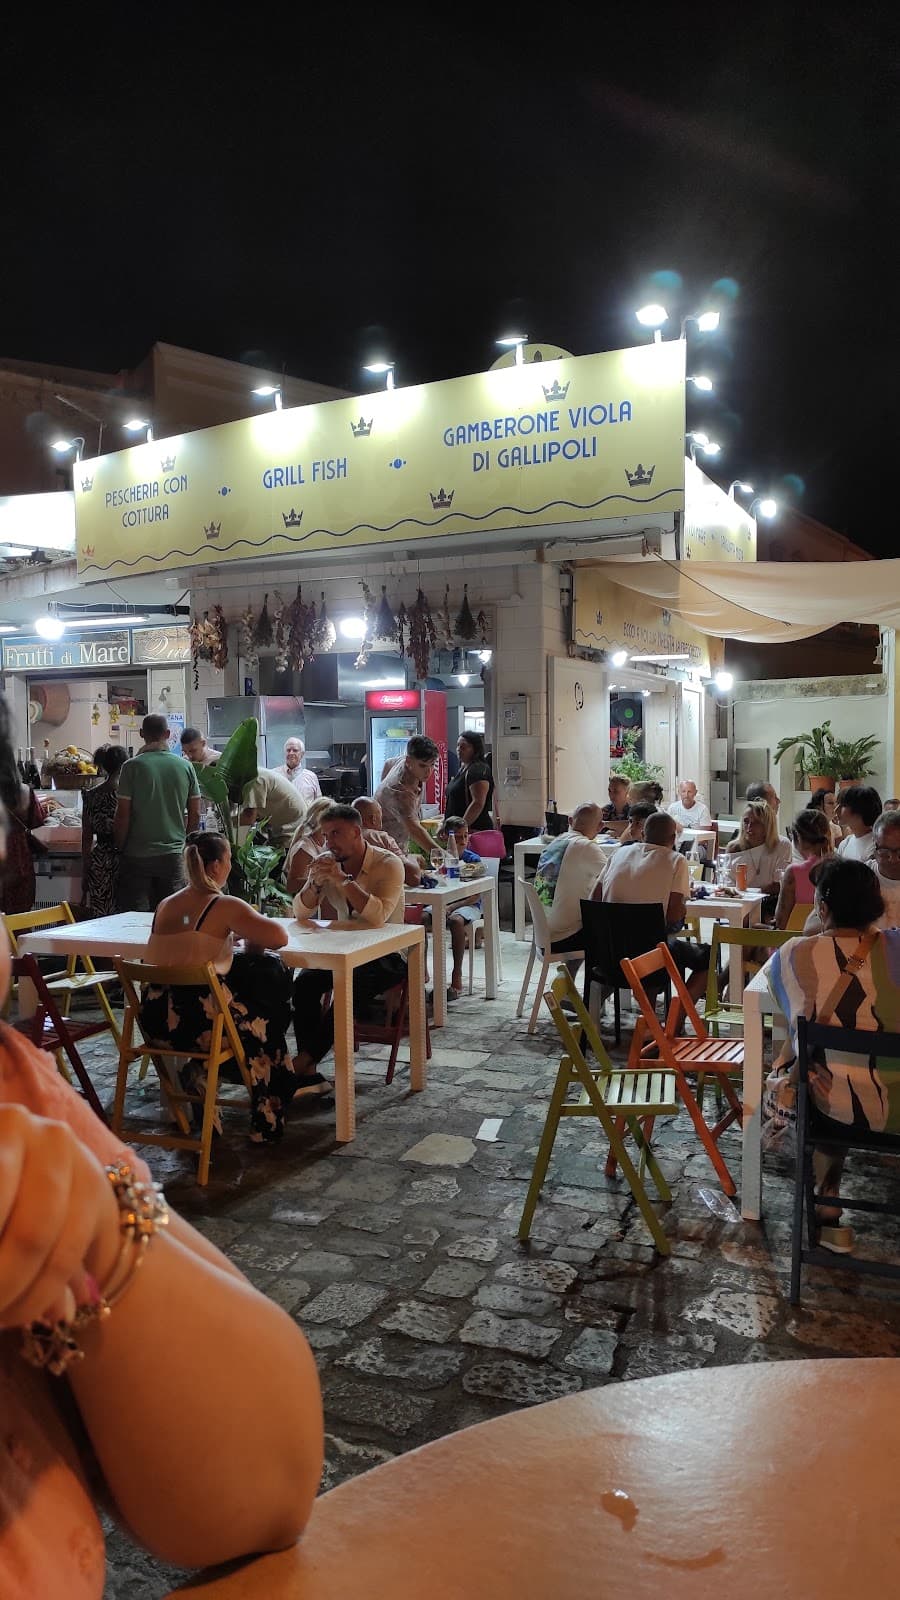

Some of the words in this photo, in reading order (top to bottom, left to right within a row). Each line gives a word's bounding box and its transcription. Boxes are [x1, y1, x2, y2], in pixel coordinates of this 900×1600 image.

[443, 410, 560, 447] GAMBERONE
[568, 400, 632, 429] VIOLA
[472, 450, 490, 472] DI
[497, 436, 597, 468] GALLIPOLI
[263, 464, 305, 489] GRILL
[312, 457, 347, 482] FISH
[105, 481, 159, 508] PESCHERIA
[163, 474, 188, 495] CON
[122, 503, 169, 528] COTTURA
[5, 647, 54, 667] Frutti
[61, 652, 72, 665] di
[79, 642, 129, 664] Mare
